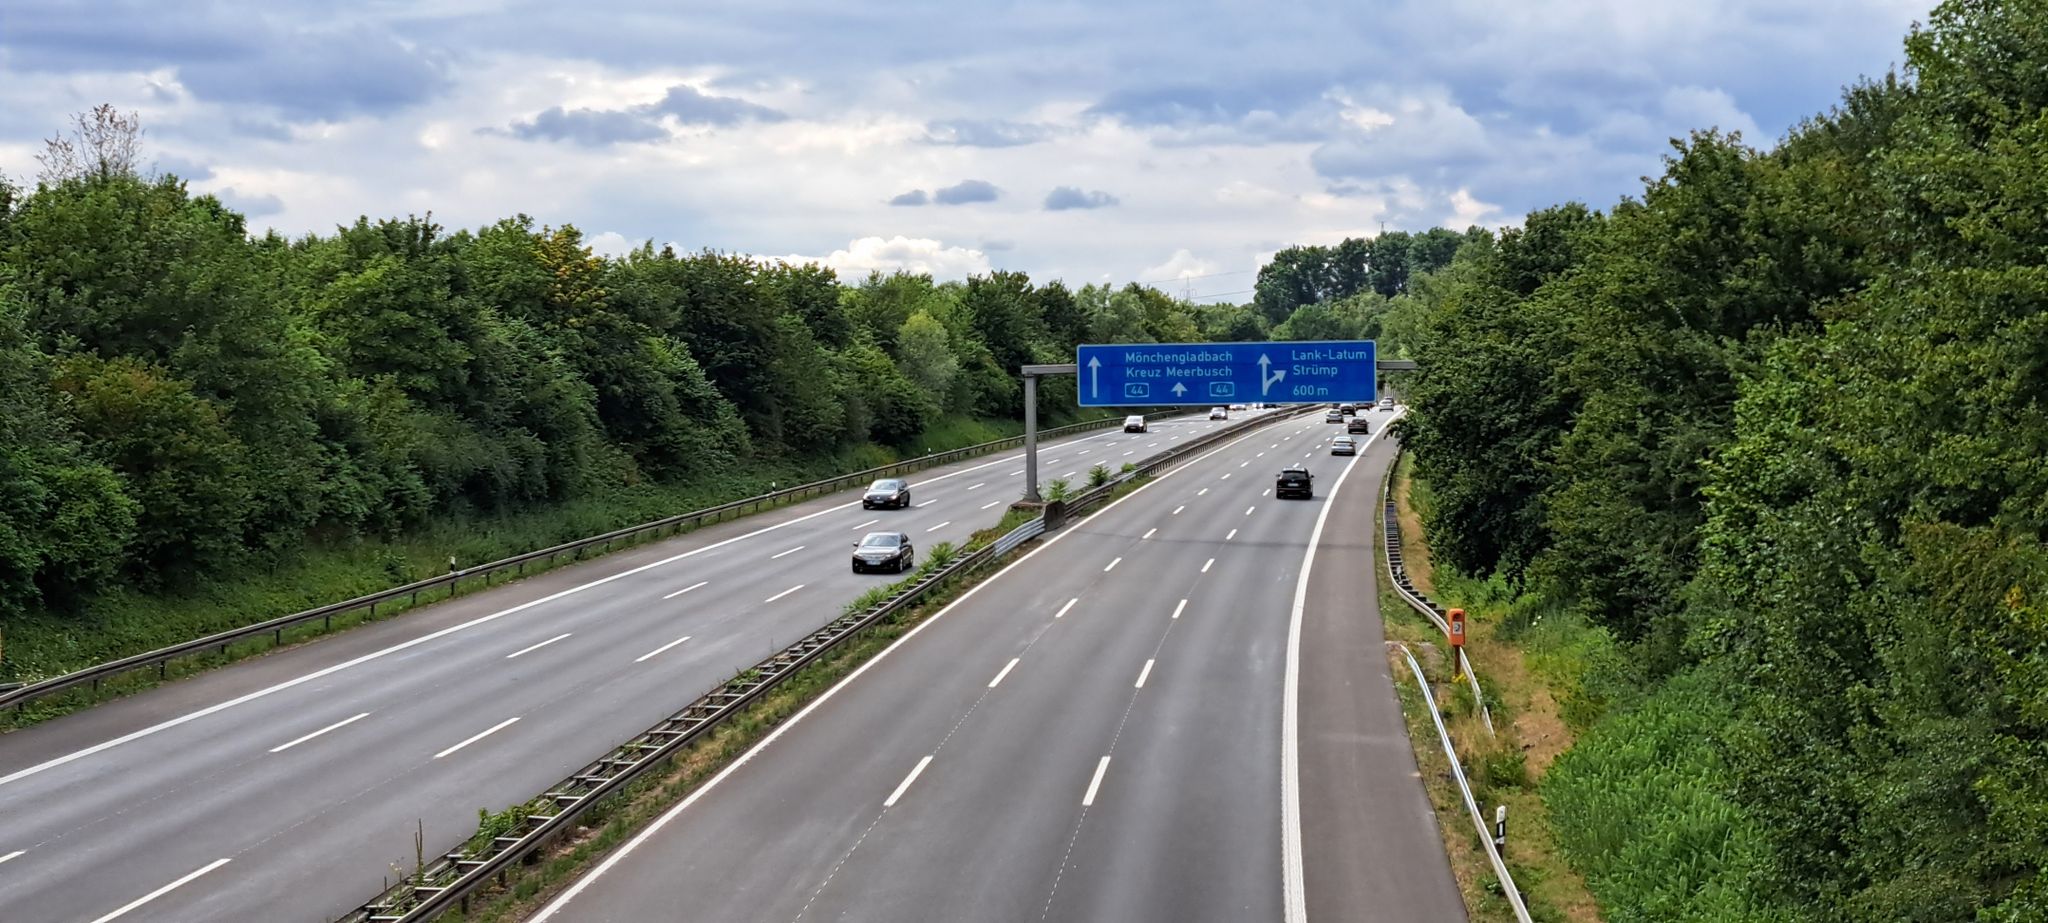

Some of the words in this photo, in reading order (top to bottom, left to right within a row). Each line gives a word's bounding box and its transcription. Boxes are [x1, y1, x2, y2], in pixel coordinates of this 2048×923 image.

[1125, 351, 1233, 364] Mönchengladbach
[1293, 350, 1367, 361] Lank-Latum
[1126, 367, 1161, 377] Kreuz
[1166, 365, 1233, 377] Meerbusch
[1293, 364, 1338, 377] Strümp
[1130, 385, 1143, 394] 44
[1215, 384, 1228, 393] 44
[1293, 385, 1315, 396] 600
[1317, 387, 1329, 396] m
